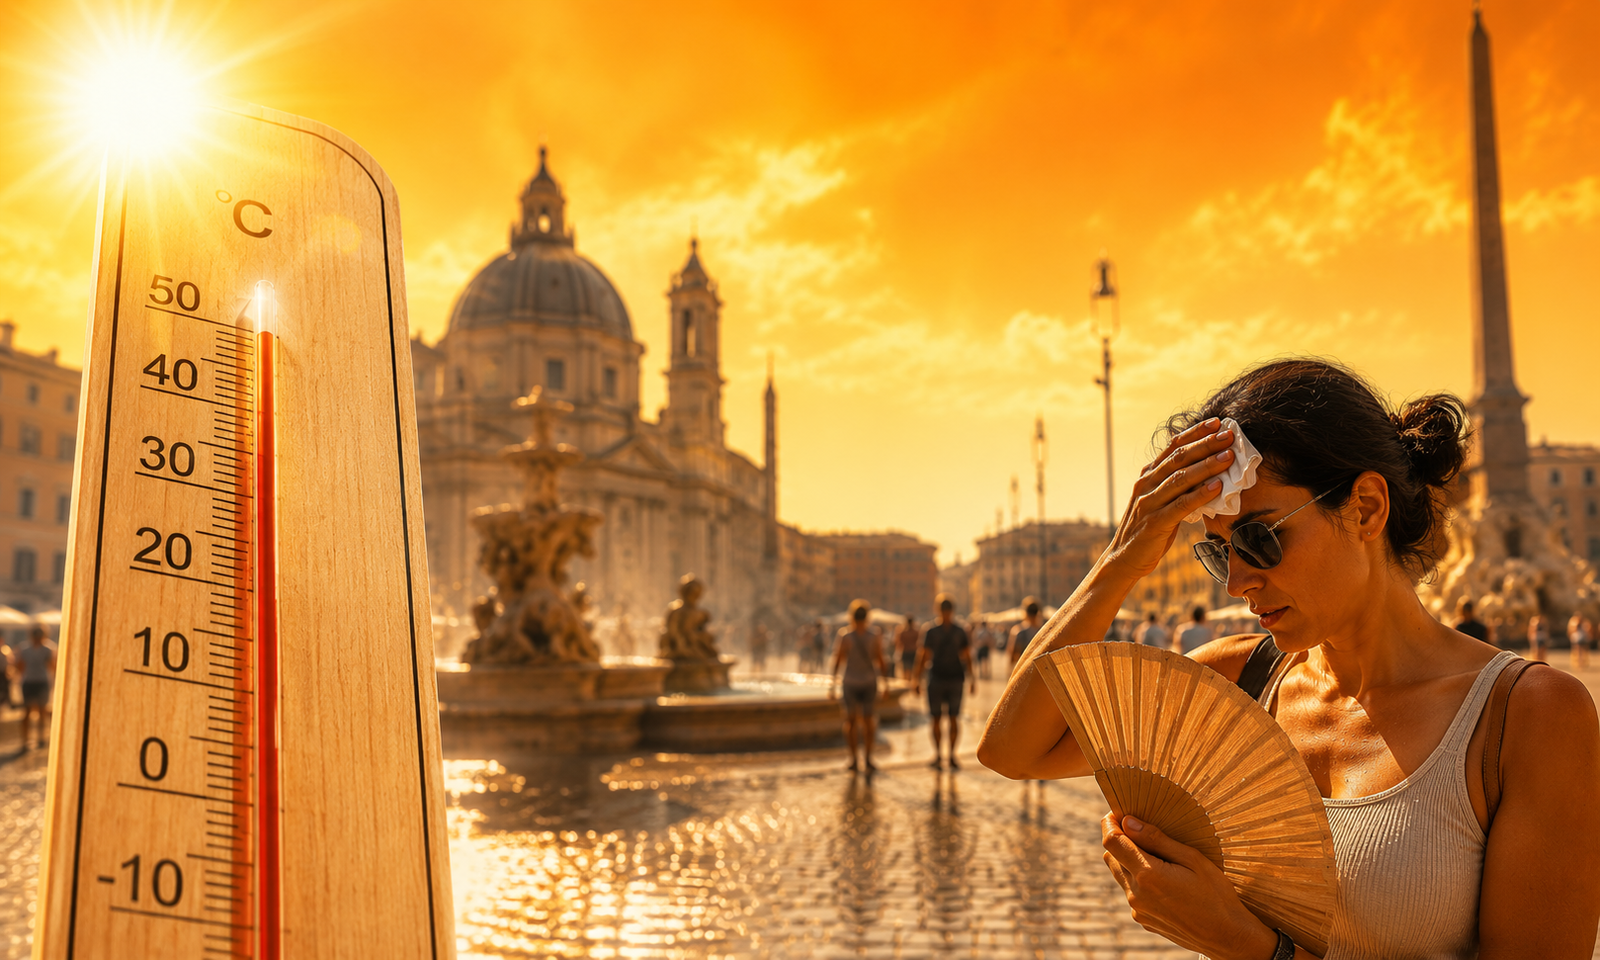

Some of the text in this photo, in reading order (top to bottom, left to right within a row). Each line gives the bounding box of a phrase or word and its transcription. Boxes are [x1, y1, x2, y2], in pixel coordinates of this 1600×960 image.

[215, 189, 273, 239] °C
[148, 274, 201, 312] 50
[142, 353, 198, 392] 40
[139, 435, 195, 478] 30
[132, 526, 192, 571] 20
[133, 626, 190, 673] 10
[139, 736, 169, 782] 0
[97, 854, 184, 907] -10
